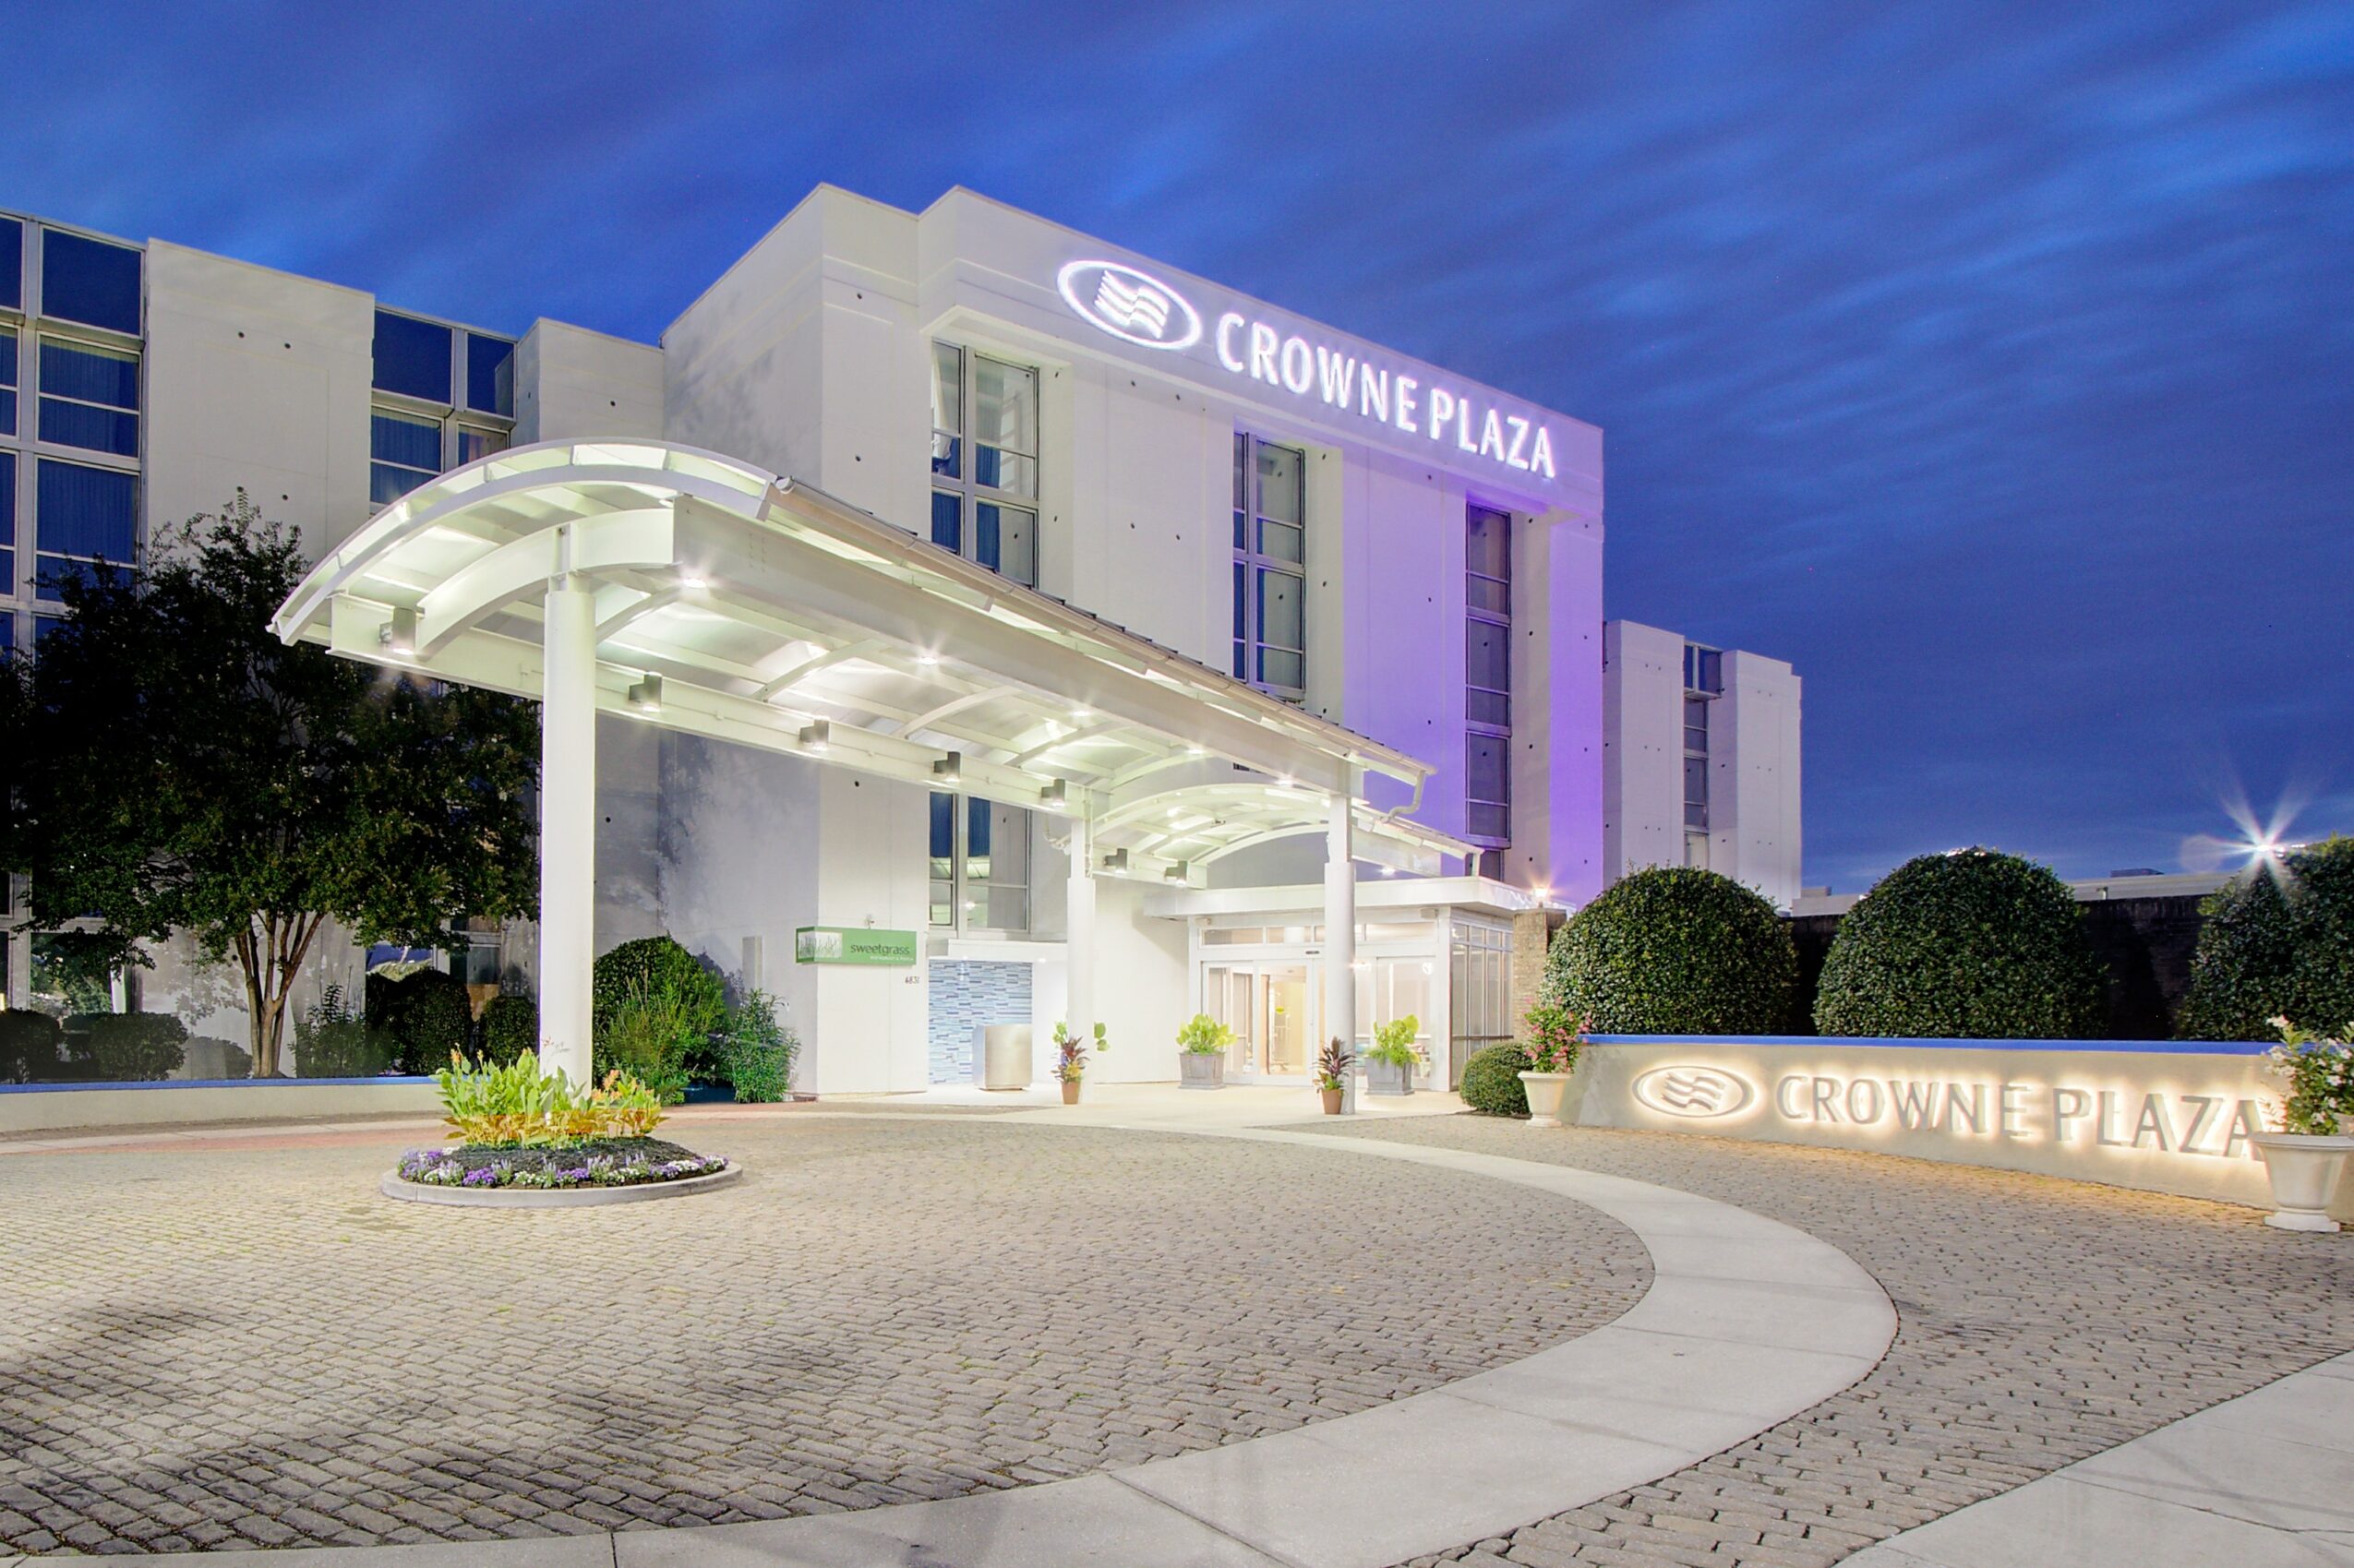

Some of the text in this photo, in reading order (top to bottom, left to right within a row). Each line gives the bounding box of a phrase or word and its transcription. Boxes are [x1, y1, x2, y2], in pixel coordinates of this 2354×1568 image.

[1215, 312, 1556, 479] CROWNE PLAZA
[850, 943, 910, 956] sweetgrass
[1776, 1074, 2265, 1162] CROWNE PLAZA
